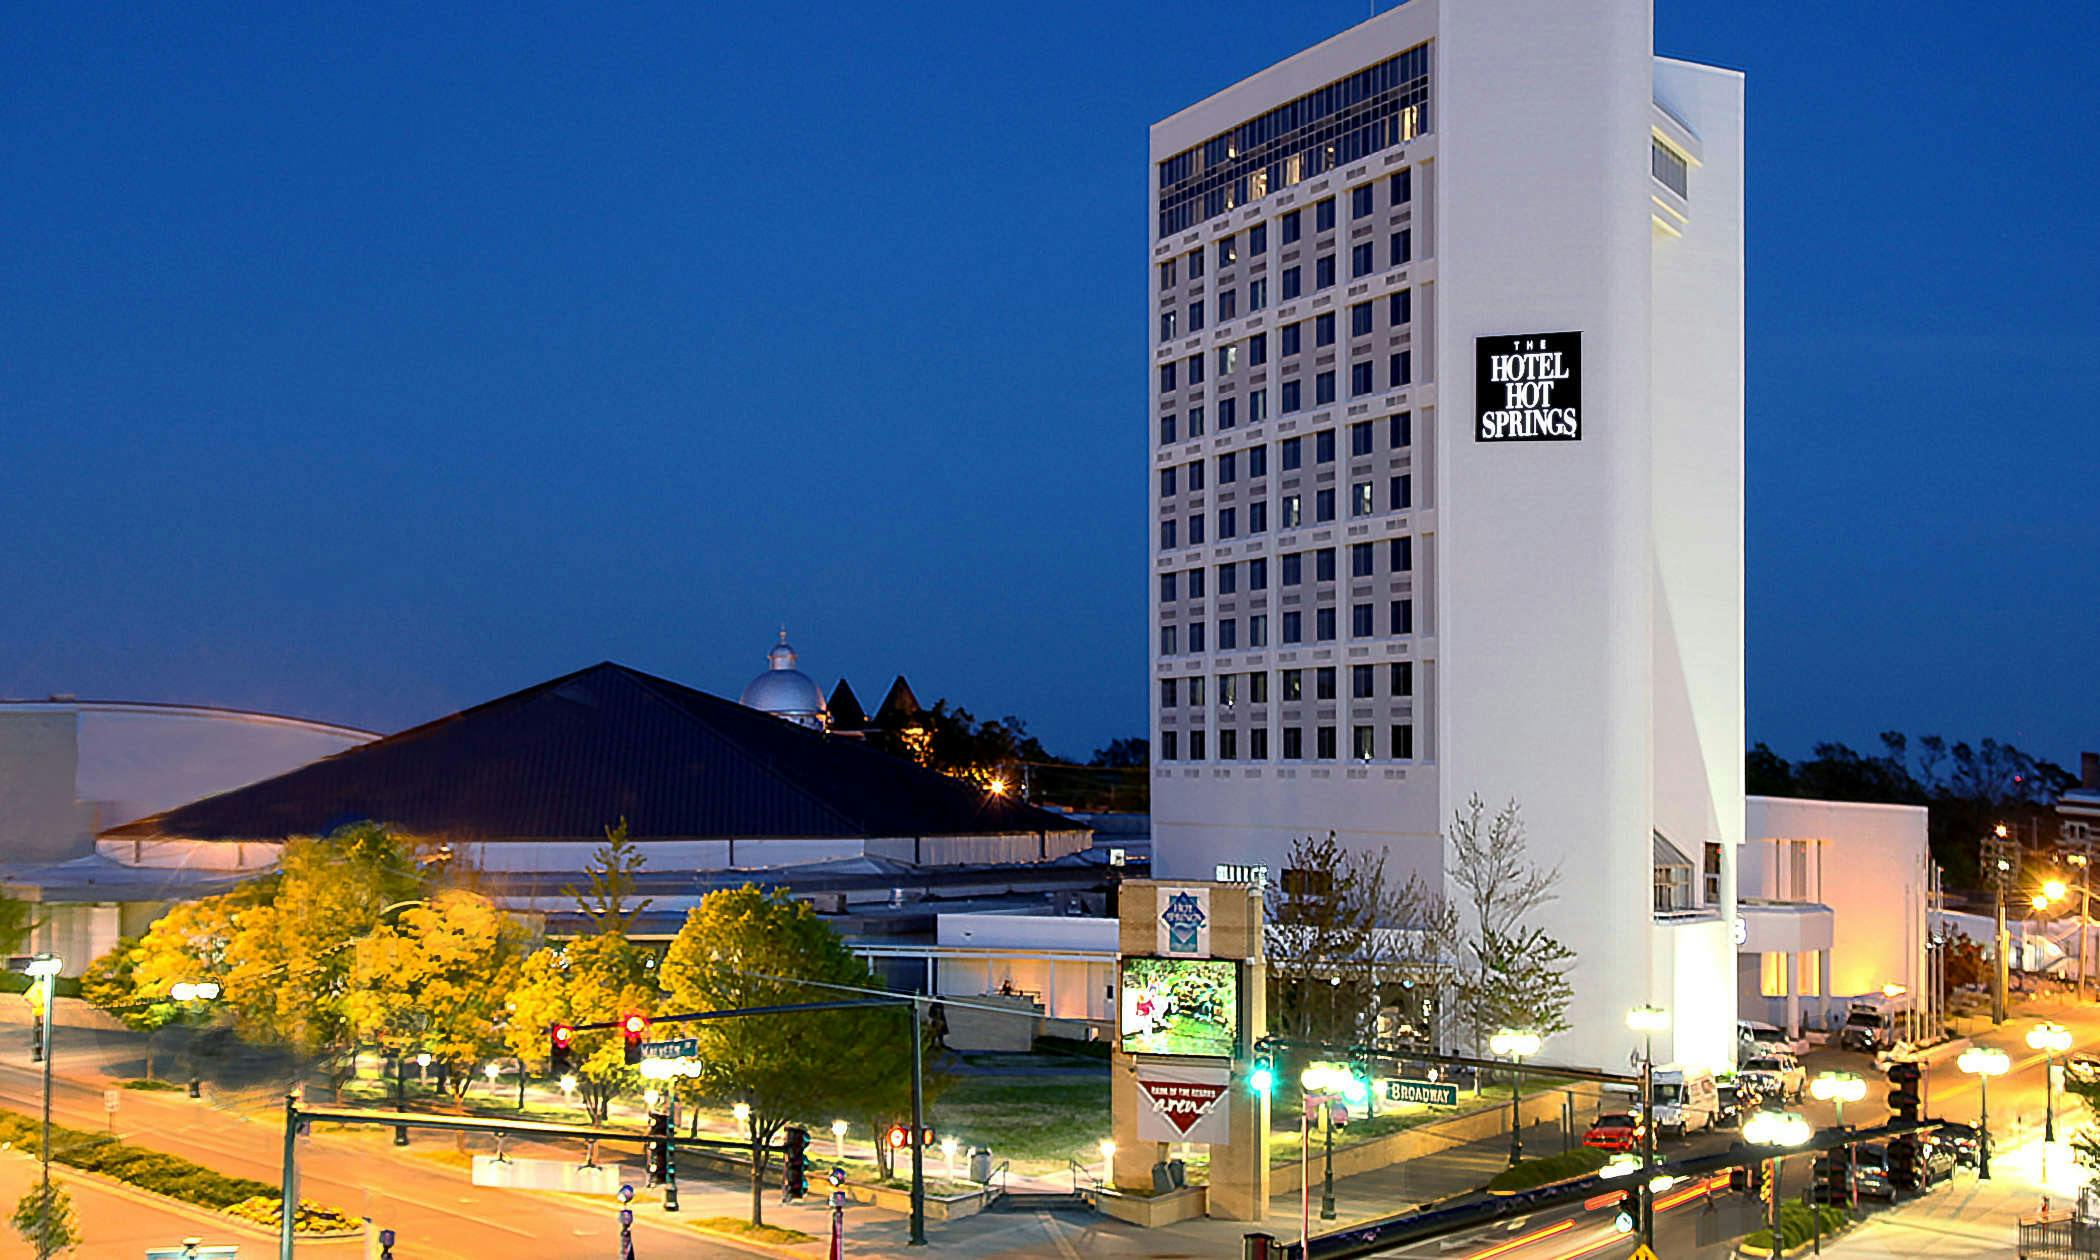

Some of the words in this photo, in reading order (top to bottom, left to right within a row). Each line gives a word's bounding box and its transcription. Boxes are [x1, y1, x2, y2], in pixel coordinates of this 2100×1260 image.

[1513, 339, 1546, 351] THE
[1490, 352, 1570, 382] HOTEL
[1505, 380, 1555, 409] HOT
[1482, 407, 1577, 439] SPRINGS
[1152, 1098, 1215, 1114] arena
